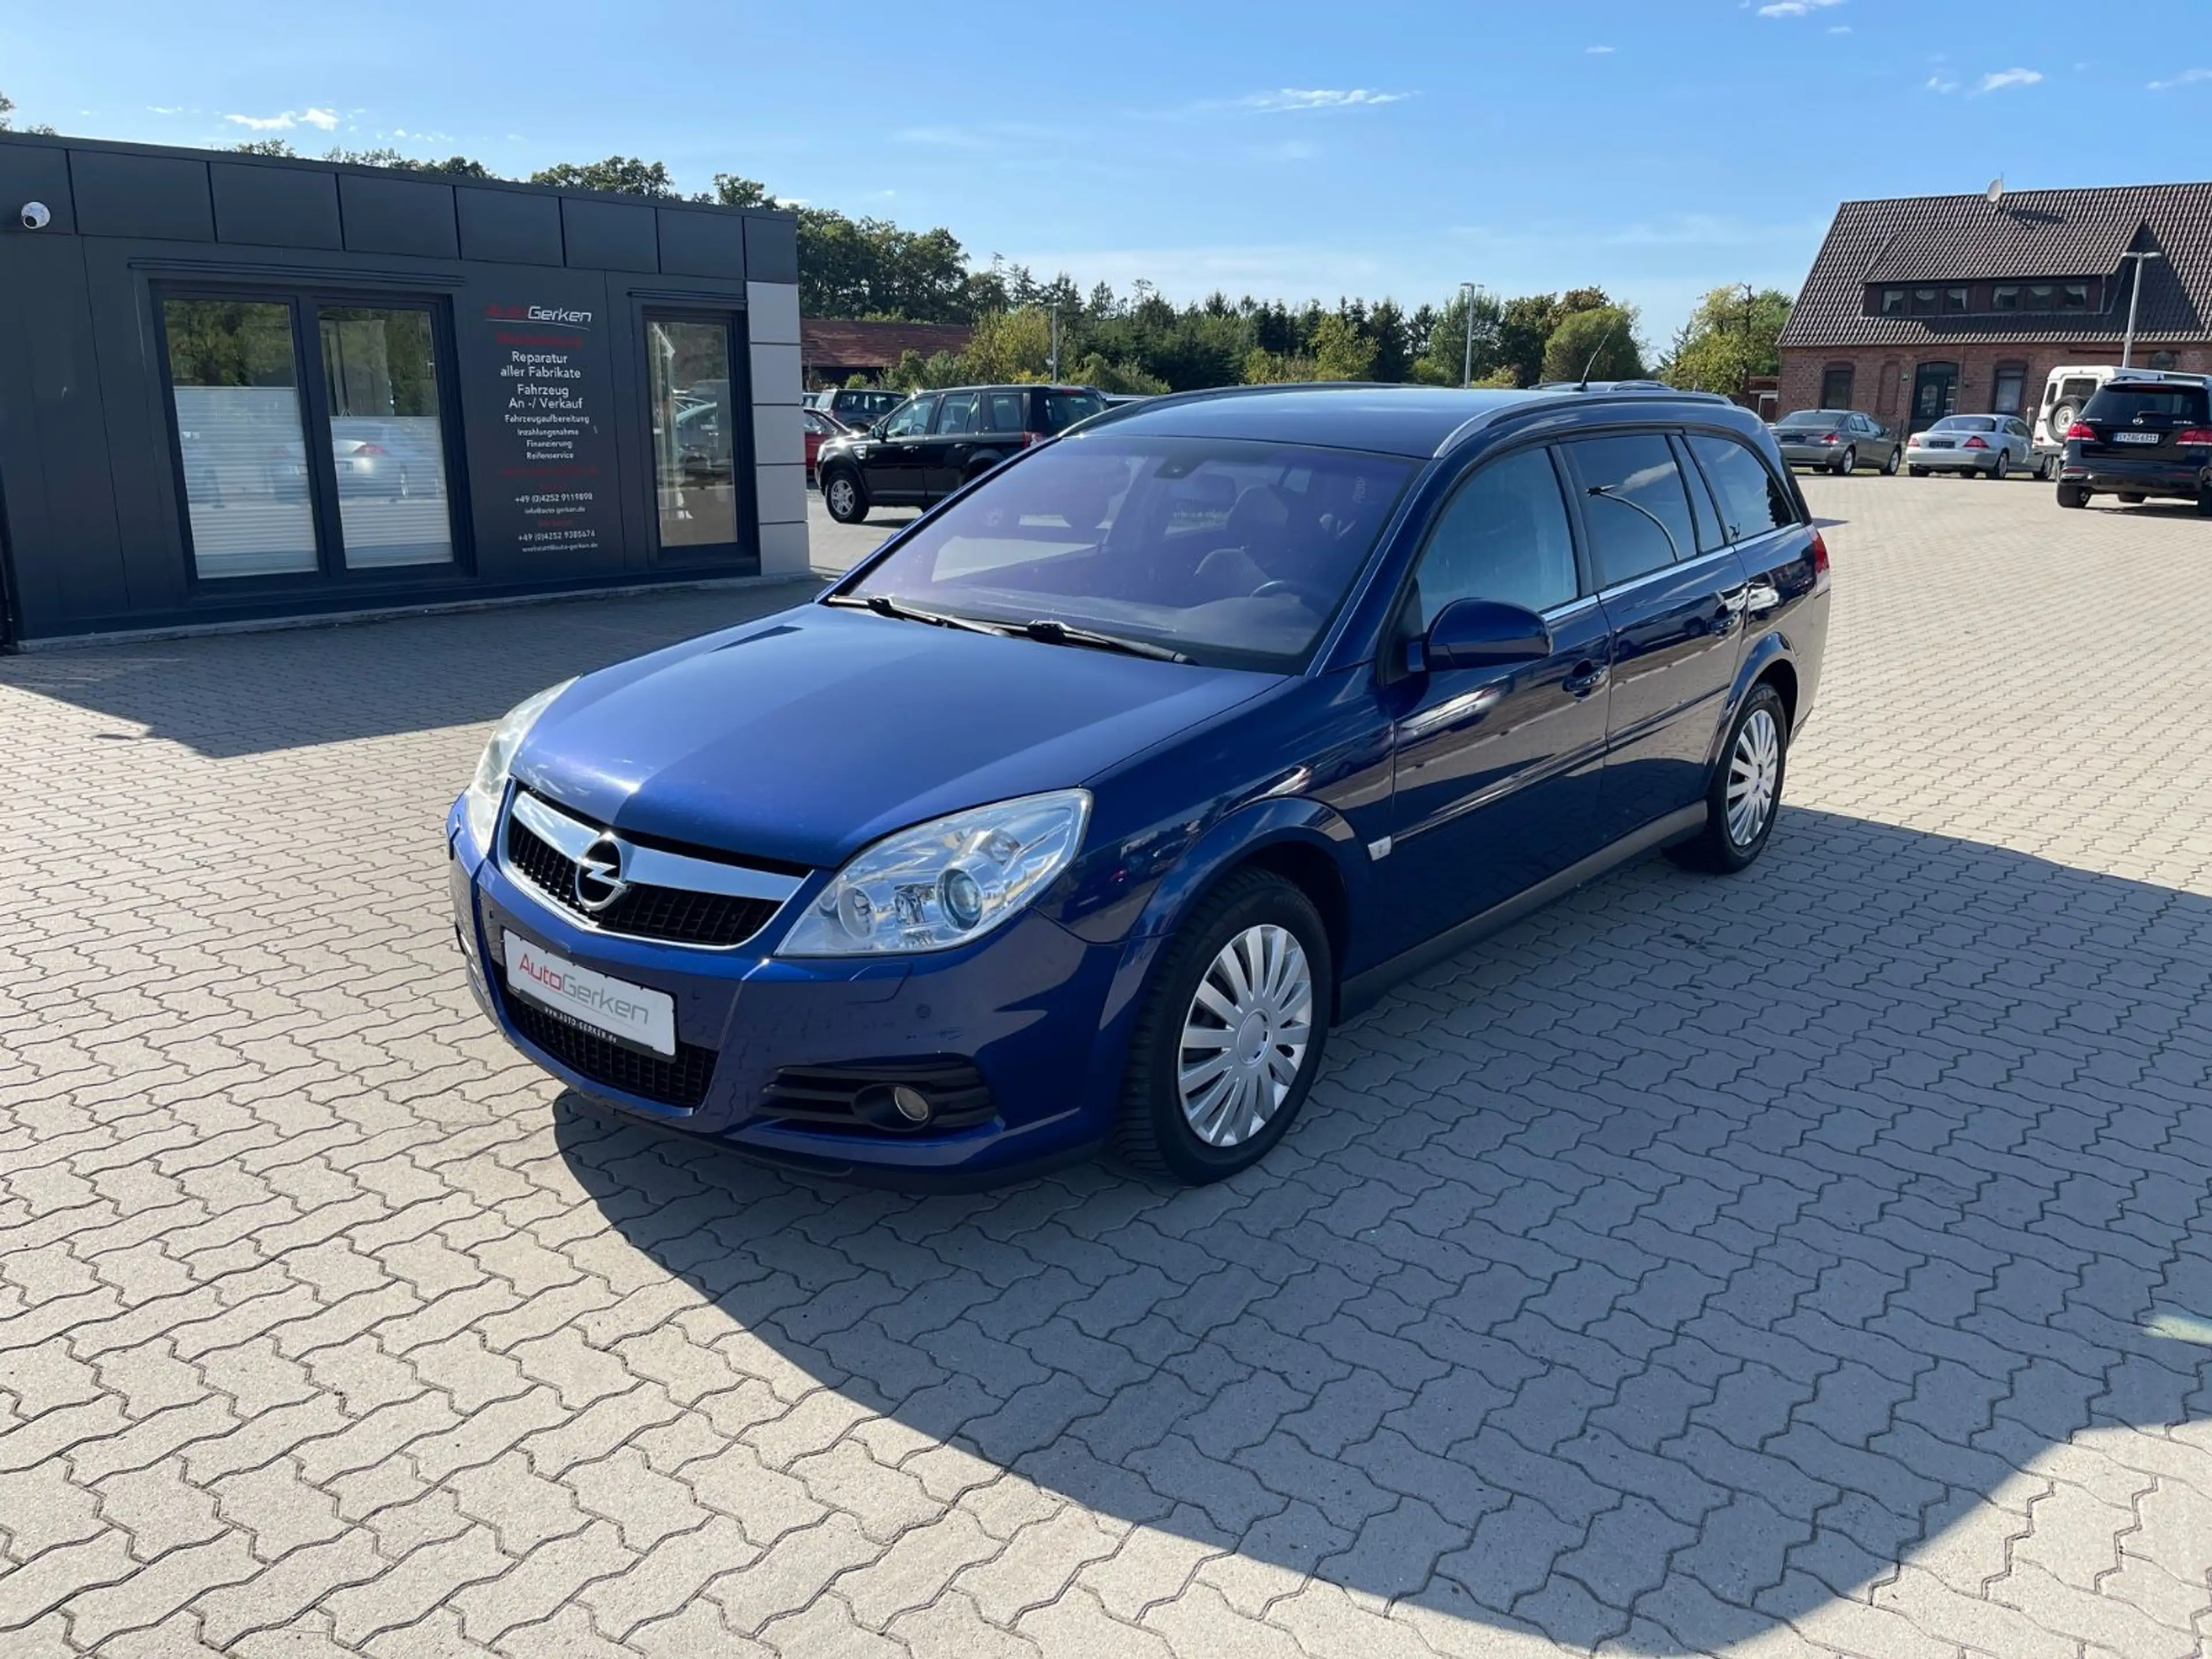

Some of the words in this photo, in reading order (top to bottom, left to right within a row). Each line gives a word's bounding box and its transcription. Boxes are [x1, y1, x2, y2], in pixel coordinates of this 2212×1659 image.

[486, 302, 592, 322] AGerken
[512, 351, 568, 365] Reparatur
[501, 365, 525, 377] aller
[528, 366, 581, 378] Fabrikate
[517, 384, 569, 397] Fahrzeug
[509, 398, 525, 408] An
[540, 398, 583, 409] Verkauf
[505, 414, 590, 425] Fahrzeugaufbereitung
[527, 440, 573, 449] Finanzierung
[527, 452, 574, 460] Reifenservice
[514, 494, 530, 503] +49
[519, 953, 649, 1025] AutoGerken
